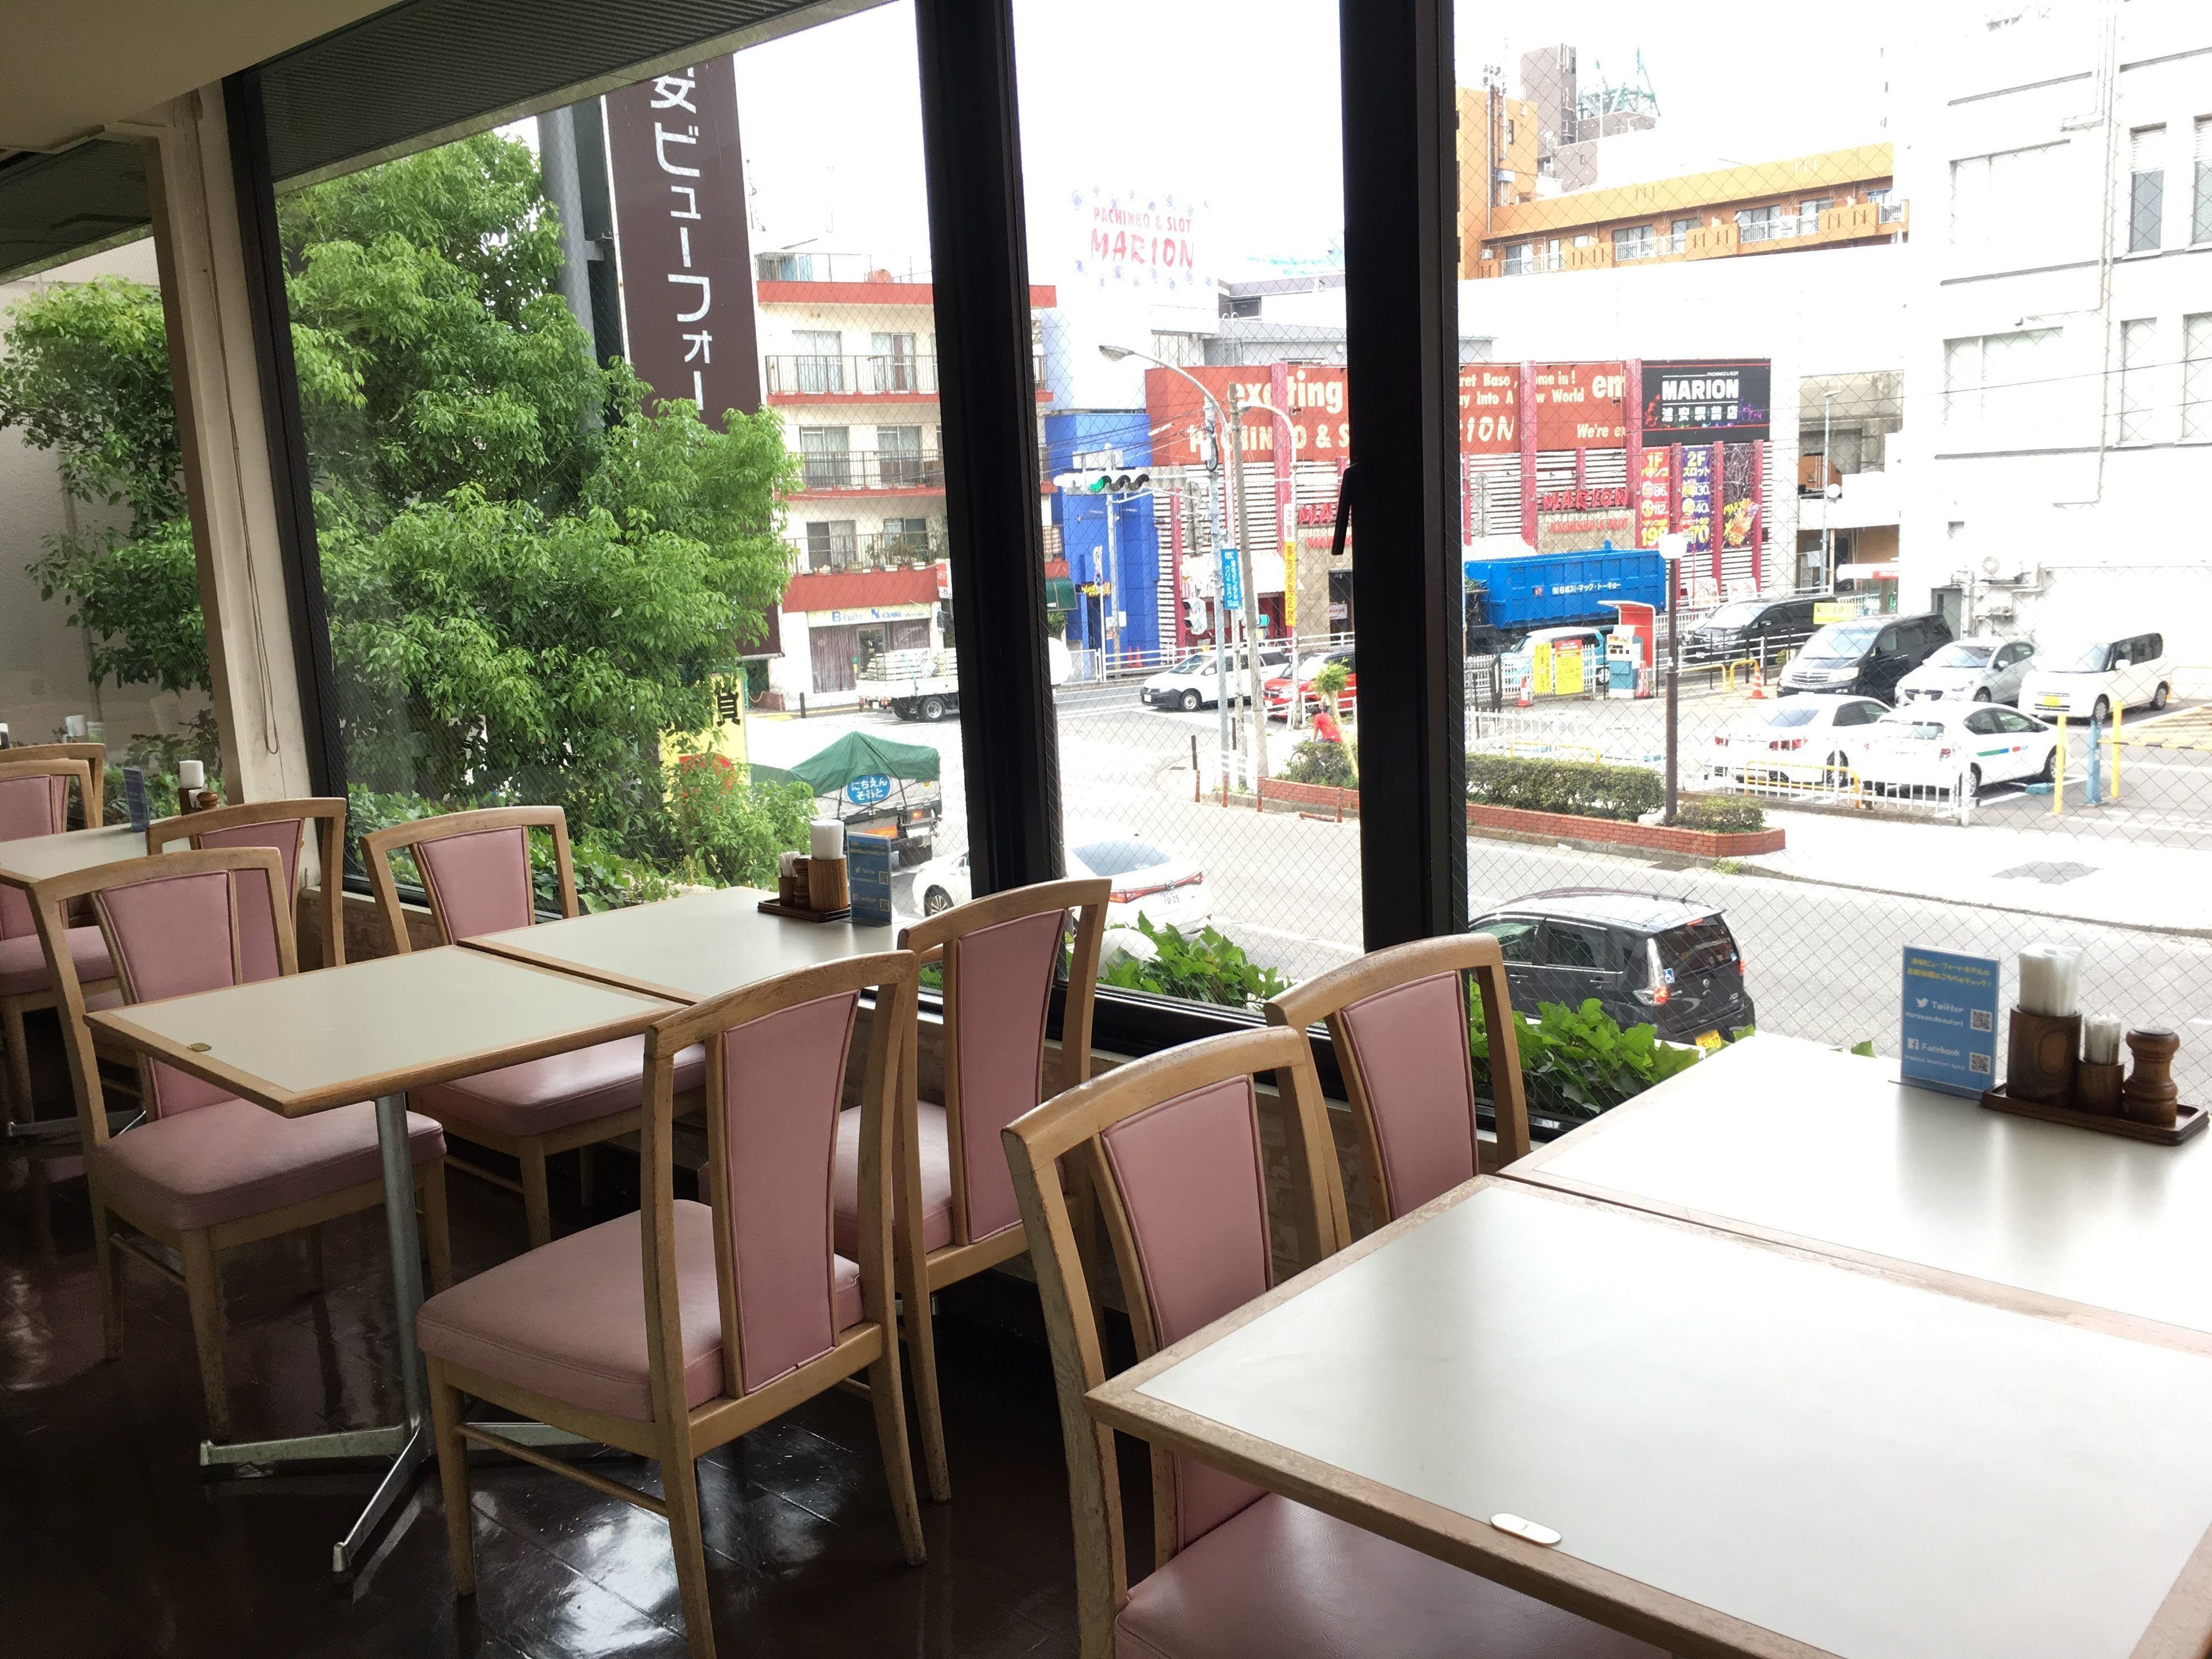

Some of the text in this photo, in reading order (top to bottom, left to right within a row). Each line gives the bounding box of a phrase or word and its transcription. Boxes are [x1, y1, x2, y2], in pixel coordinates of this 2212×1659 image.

[1094, 207, 1150, 228] PACHINKO
[1167, 216, 1192, 233] SLOT
[1091, 228, 1195, 268] MARION
[1552, 387, 1585, 403] World
[1662, 379, 1739, 401] MARION
[1476, 391, 1500, 406] into
[1577, 423, 1609, 439] We're
[1647, 452, 1664, 468] 1F
[1687, 450, 1706, 467] 2F
[1641, 467, 1669, 478] パチンコ
[1682, 467, 1710, 477] スロット
[1543, 488, 1629, 512] MARION
[851, 777, 888, 791] にちえん
[1932, 1001, 1964, 1013] Twitter
[1921, 1043, 1960, 1056] Facebook
